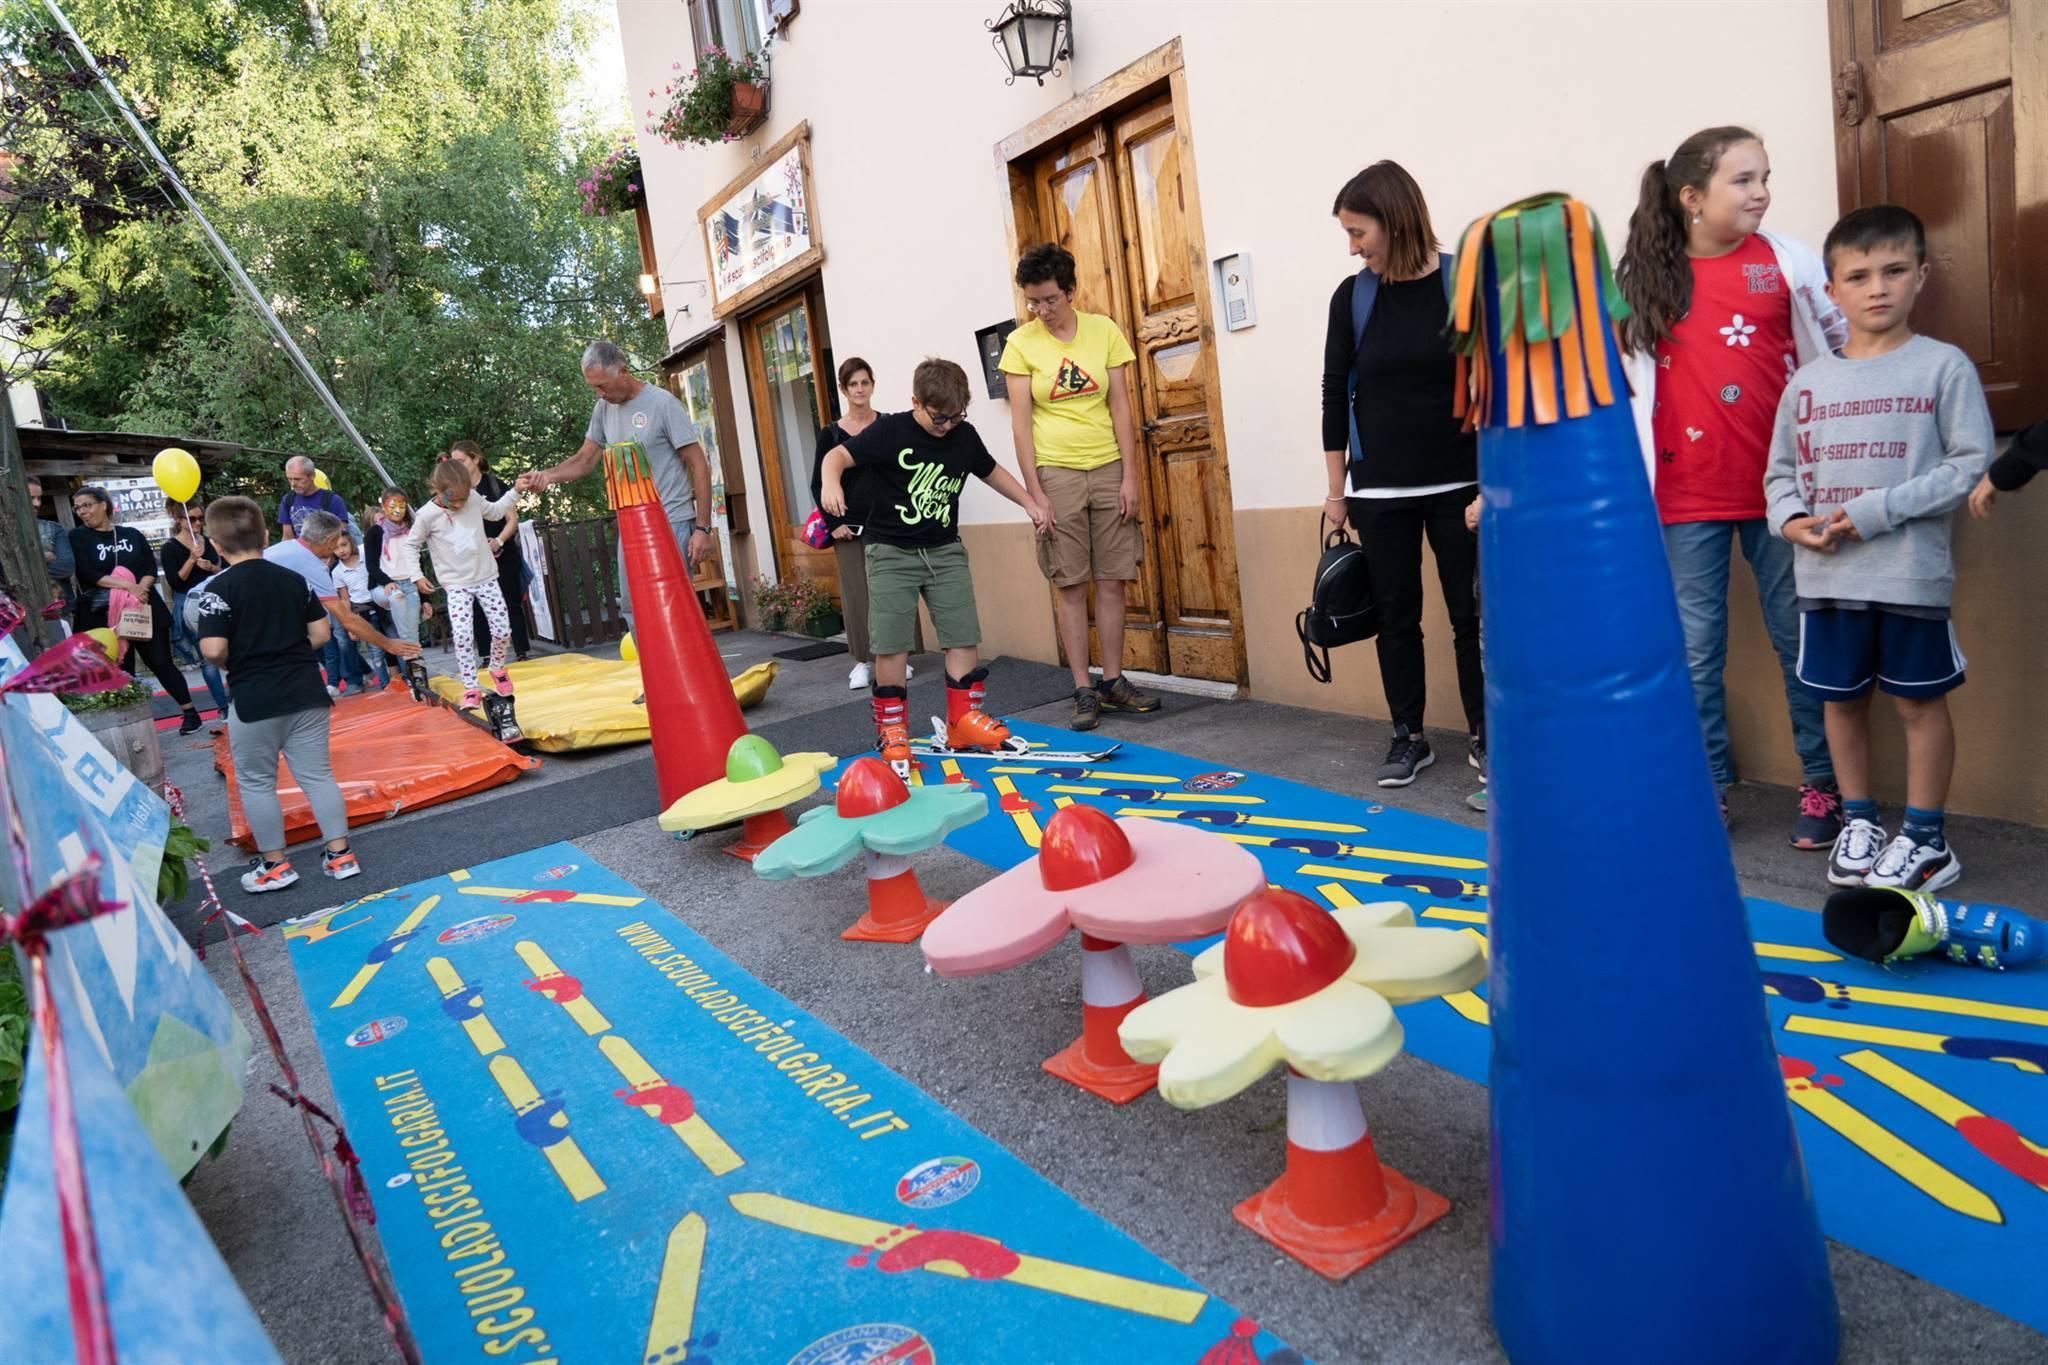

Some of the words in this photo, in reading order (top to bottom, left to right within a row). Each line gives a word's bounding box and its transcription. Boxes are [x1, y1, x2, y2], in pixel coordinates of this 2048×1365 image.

[1828, 398, 1893, 418] GLORIOUS
[1896, 396, 1936, 415] TEAM
[897, 447, 965, 494] Maui
[1869, 441, 1908, 459] CLUB
[616, 920, 910, 1140] WWW.SCUOLADISCIFOLGARIA.IT
[375, 1068, 560, 1365] .SCUOLADISCIFOLGARIA.IT
